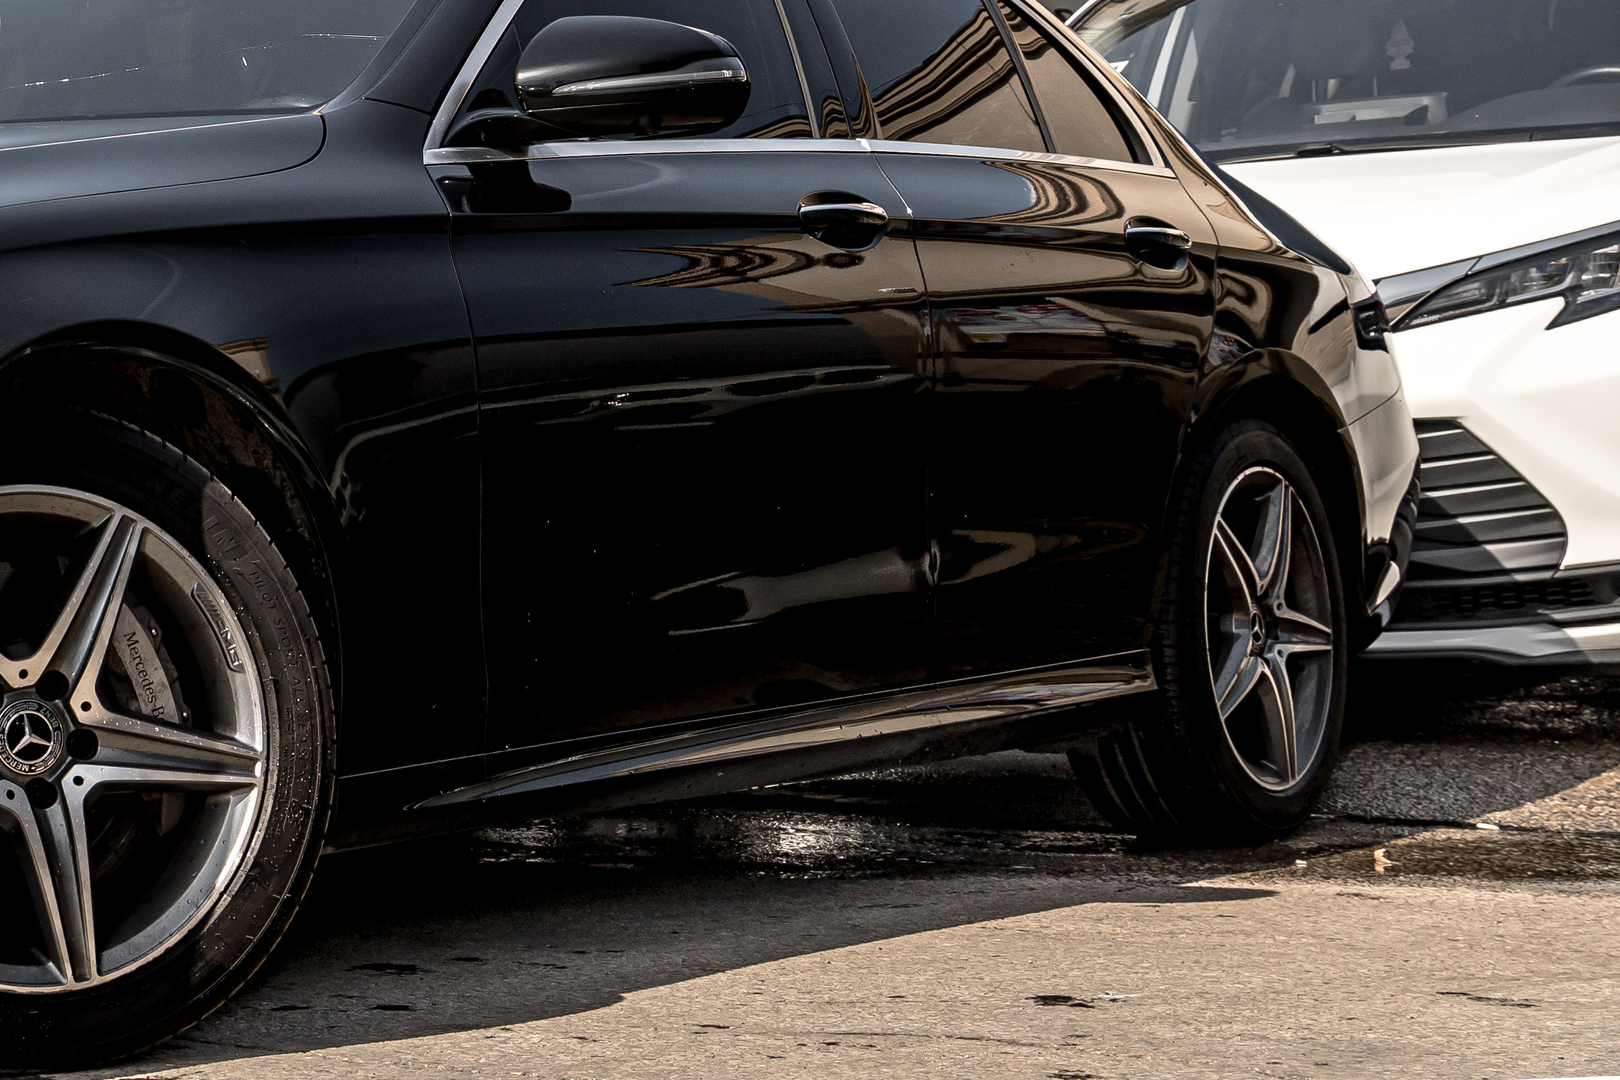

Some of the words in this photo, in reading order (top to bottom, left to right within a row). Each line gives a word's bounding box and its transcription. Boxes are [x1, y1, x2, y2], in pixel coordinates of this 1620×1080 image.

[249, 570, 279, 612] PILOT
[273, 617, 299, 667] SPORT
[39, 705, 60, 728] BENZ
[123, 630, 165, 718] Mercedes-B
